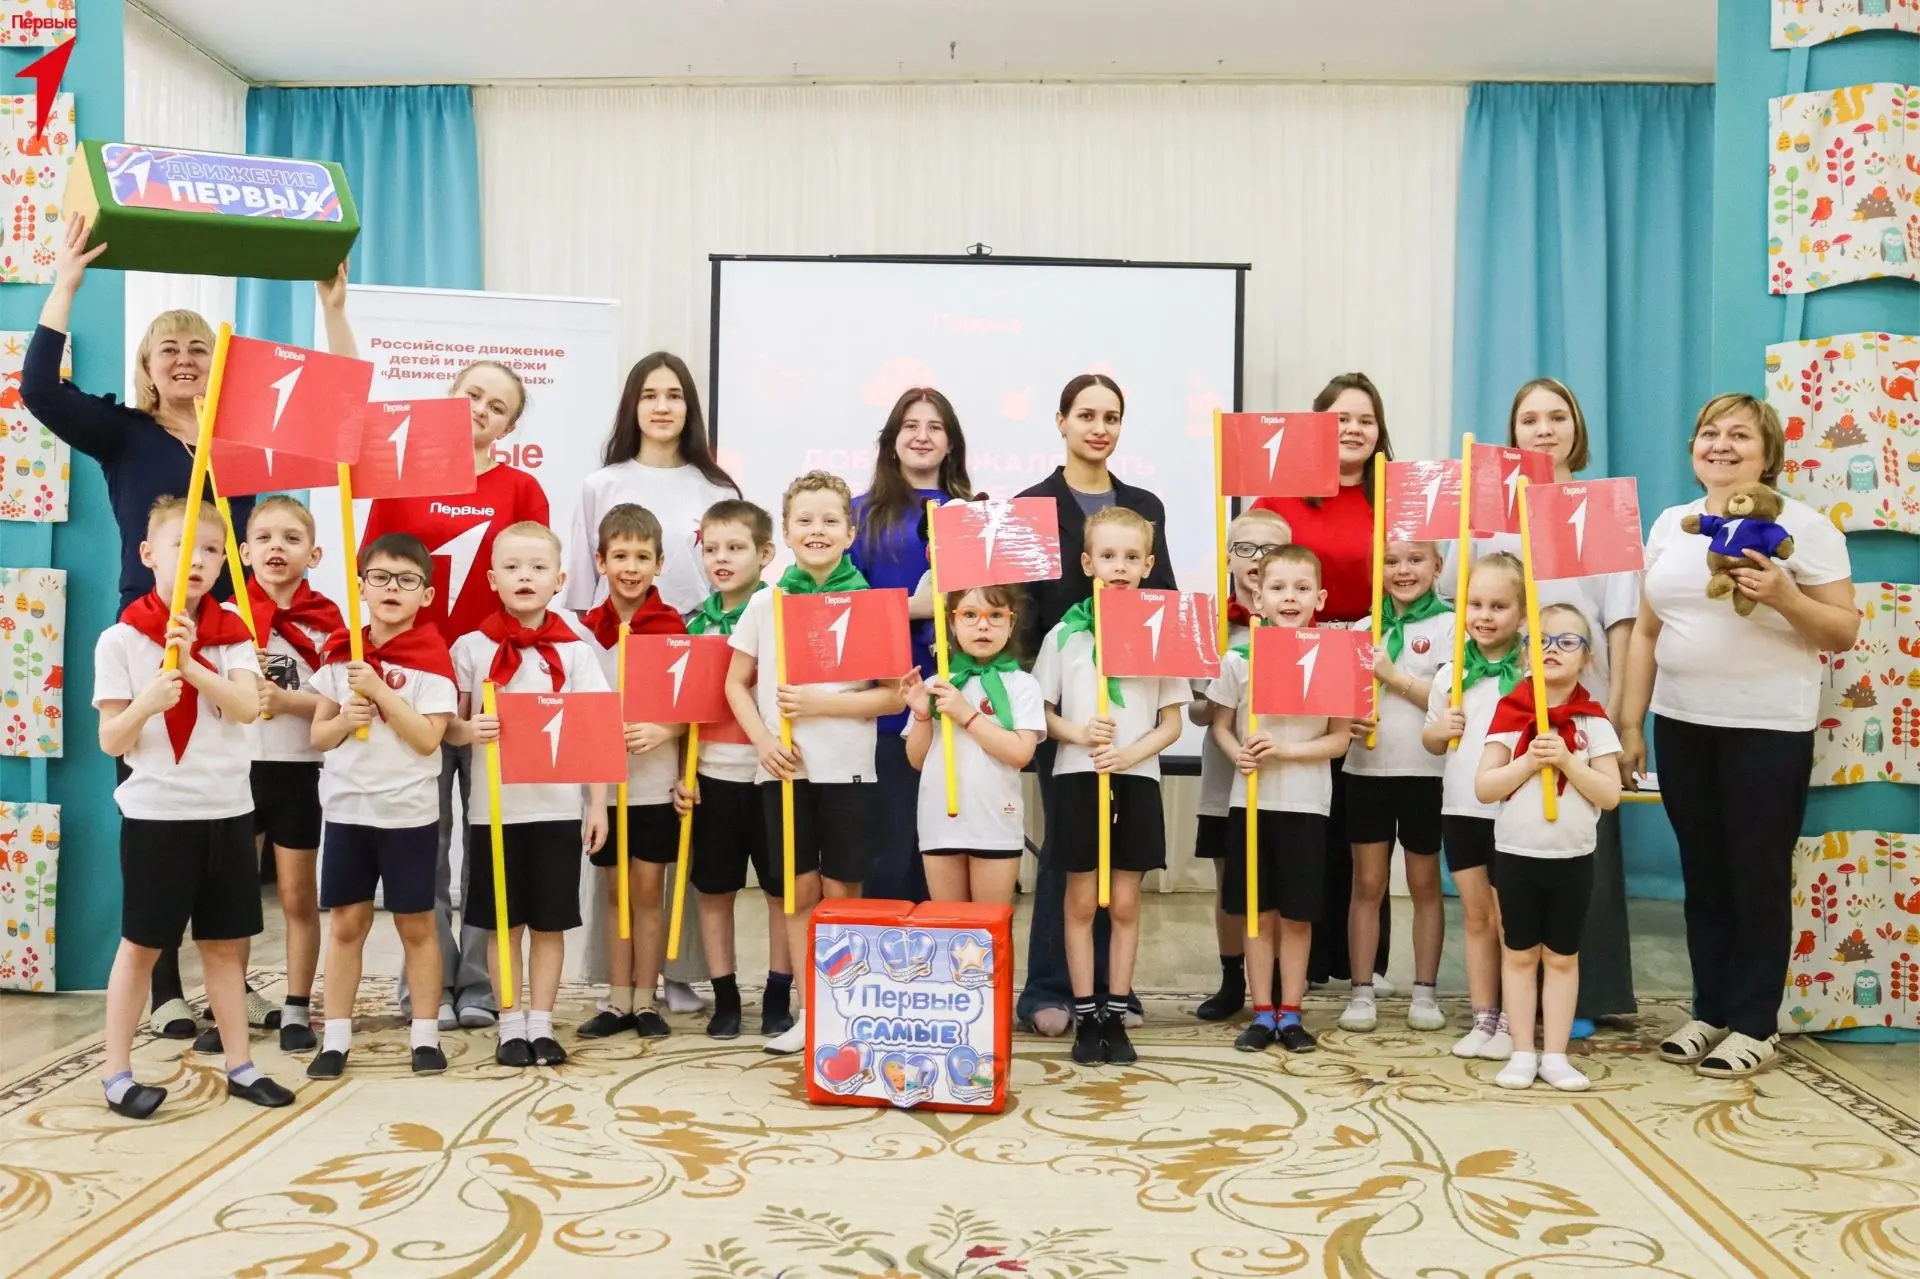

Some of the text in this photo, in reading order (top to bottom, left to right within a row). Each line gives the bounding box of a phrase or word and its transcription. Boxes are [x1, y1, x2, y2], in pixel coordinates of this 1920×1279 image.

[166, 159, 316, 189] ДВИЖЕНИЕ
[168, 180, 325, 213] ПЕРВЫХ
[370, 338, 565, 358] Российское движение
[389, 354, 441, 366] детей
[444, 356, 454, 366] и
[380, 367, 457, 380] «Движен
[429, 502, 495, 518] Первые
[861, 984, 971, 1016] Первые
[856, 1020, 957, 1044] САМЫЕ
